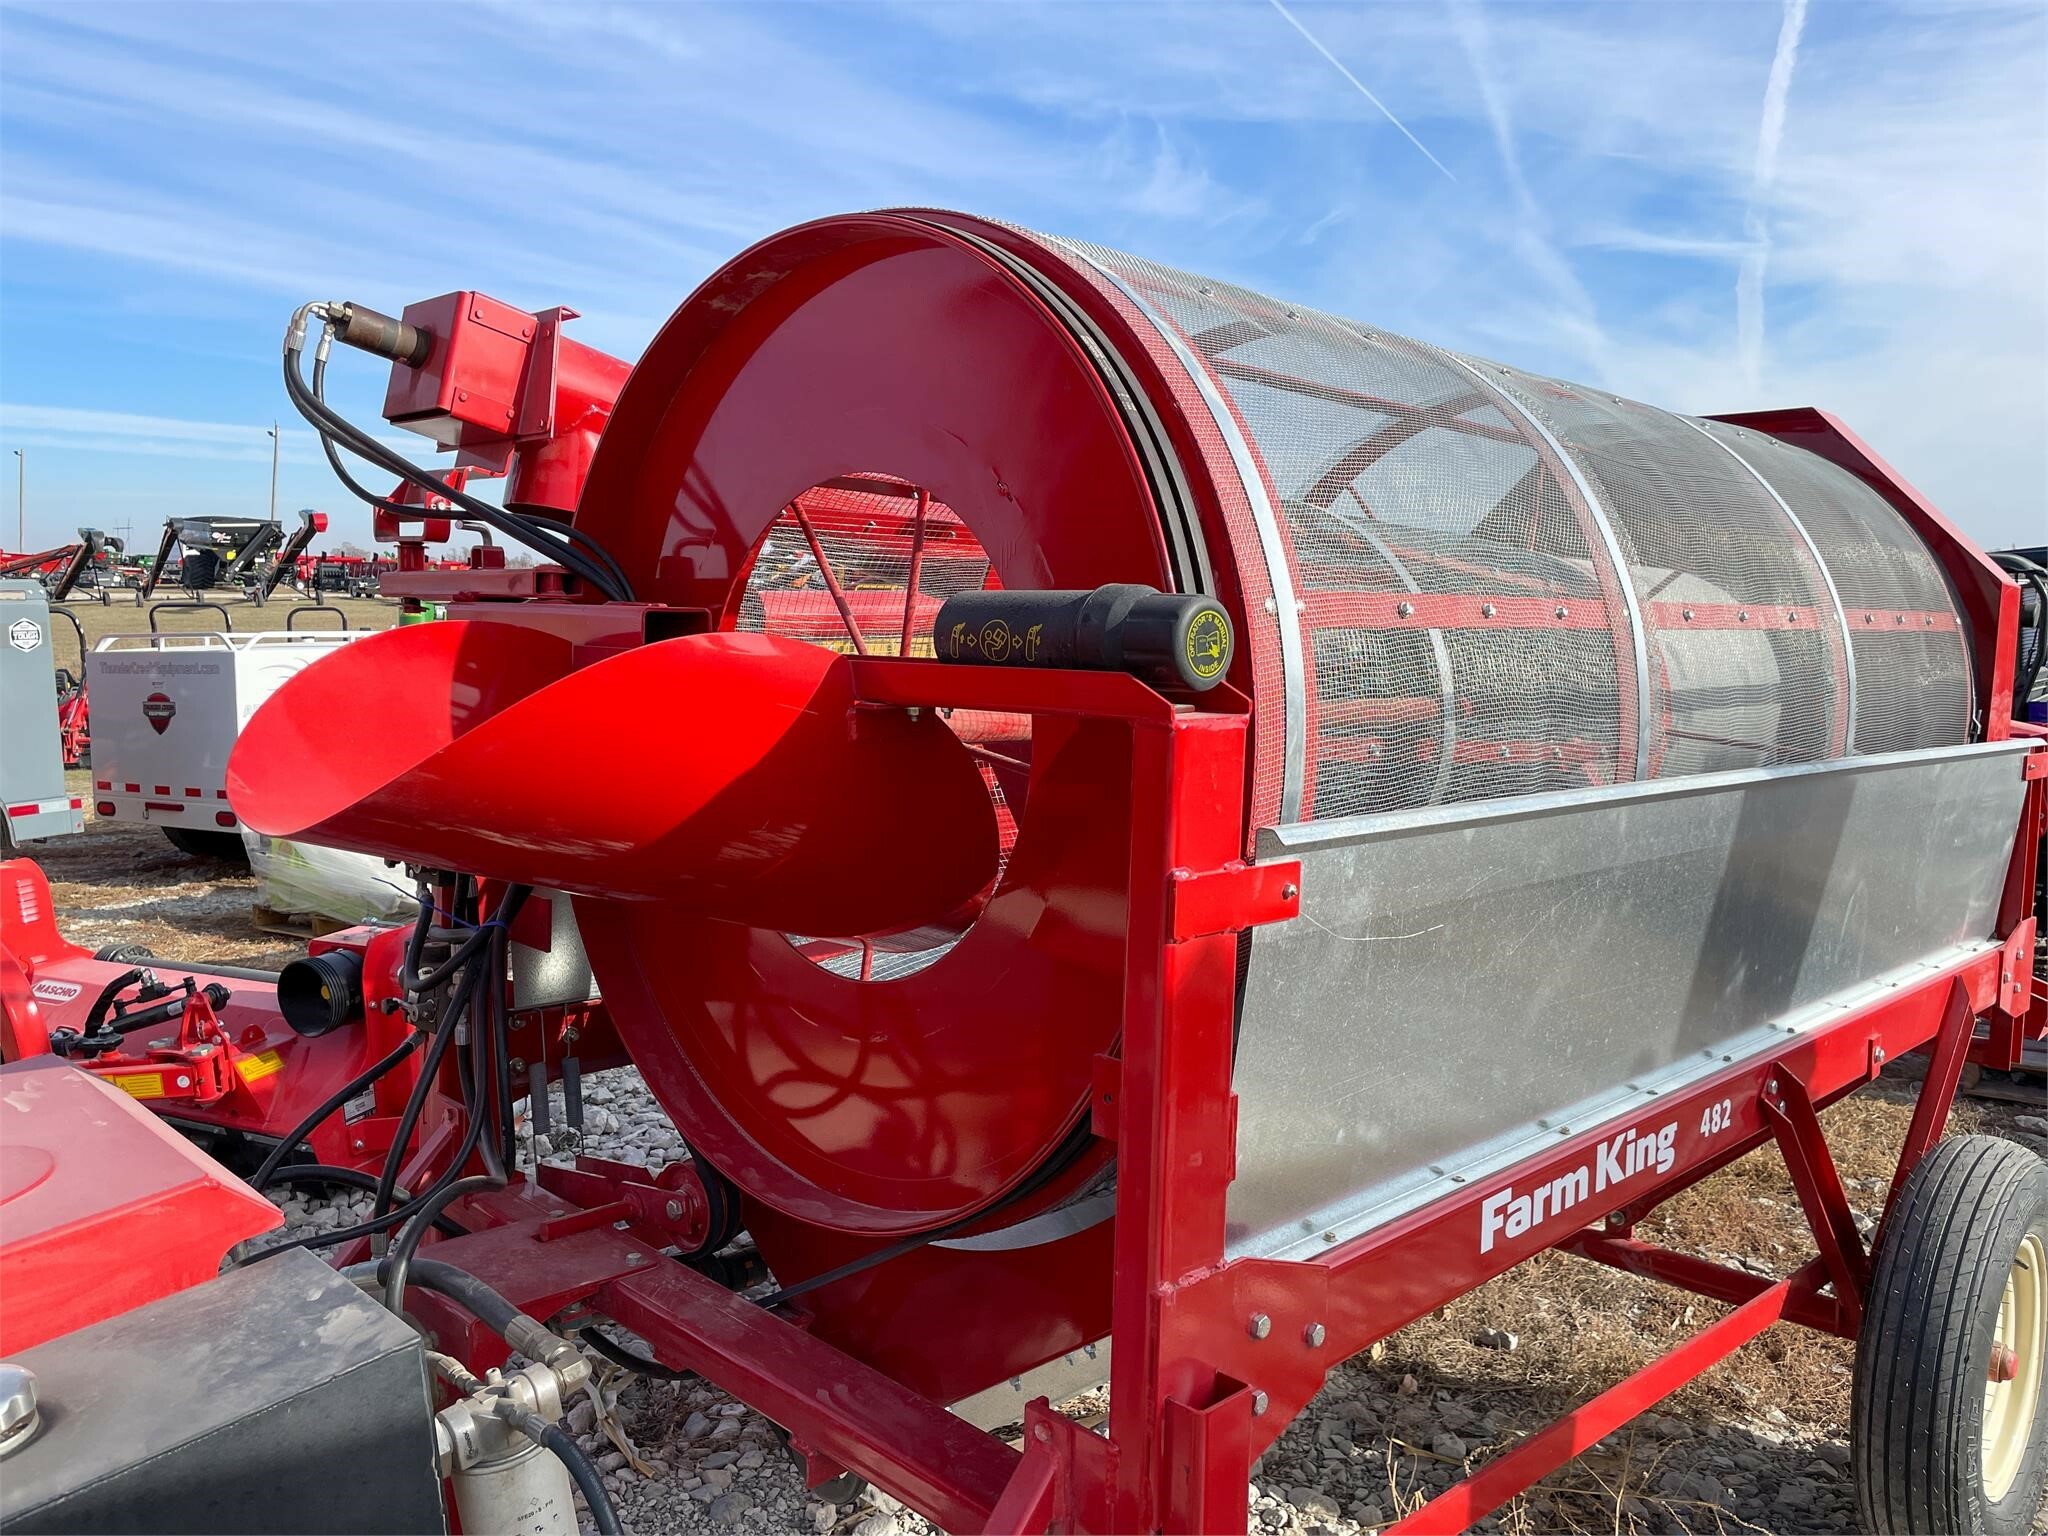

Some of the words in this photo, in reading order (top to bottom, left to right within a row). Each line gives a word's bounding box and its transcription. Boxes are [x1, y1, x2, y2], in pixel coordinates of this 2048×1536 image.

[1189, 614, 1213, 657] OPERATOR'S
[1214, 616, 1227, 650] MANUAL
[1199, 660, 1220, 673] INSIDE
[34, 984, 77, 997] MASCHIO
[1700, 1099, 1732, 1137] 482
[1480, 1165, 1589, 1254] Farm
[1595, 1121, 1678, 1194] King
